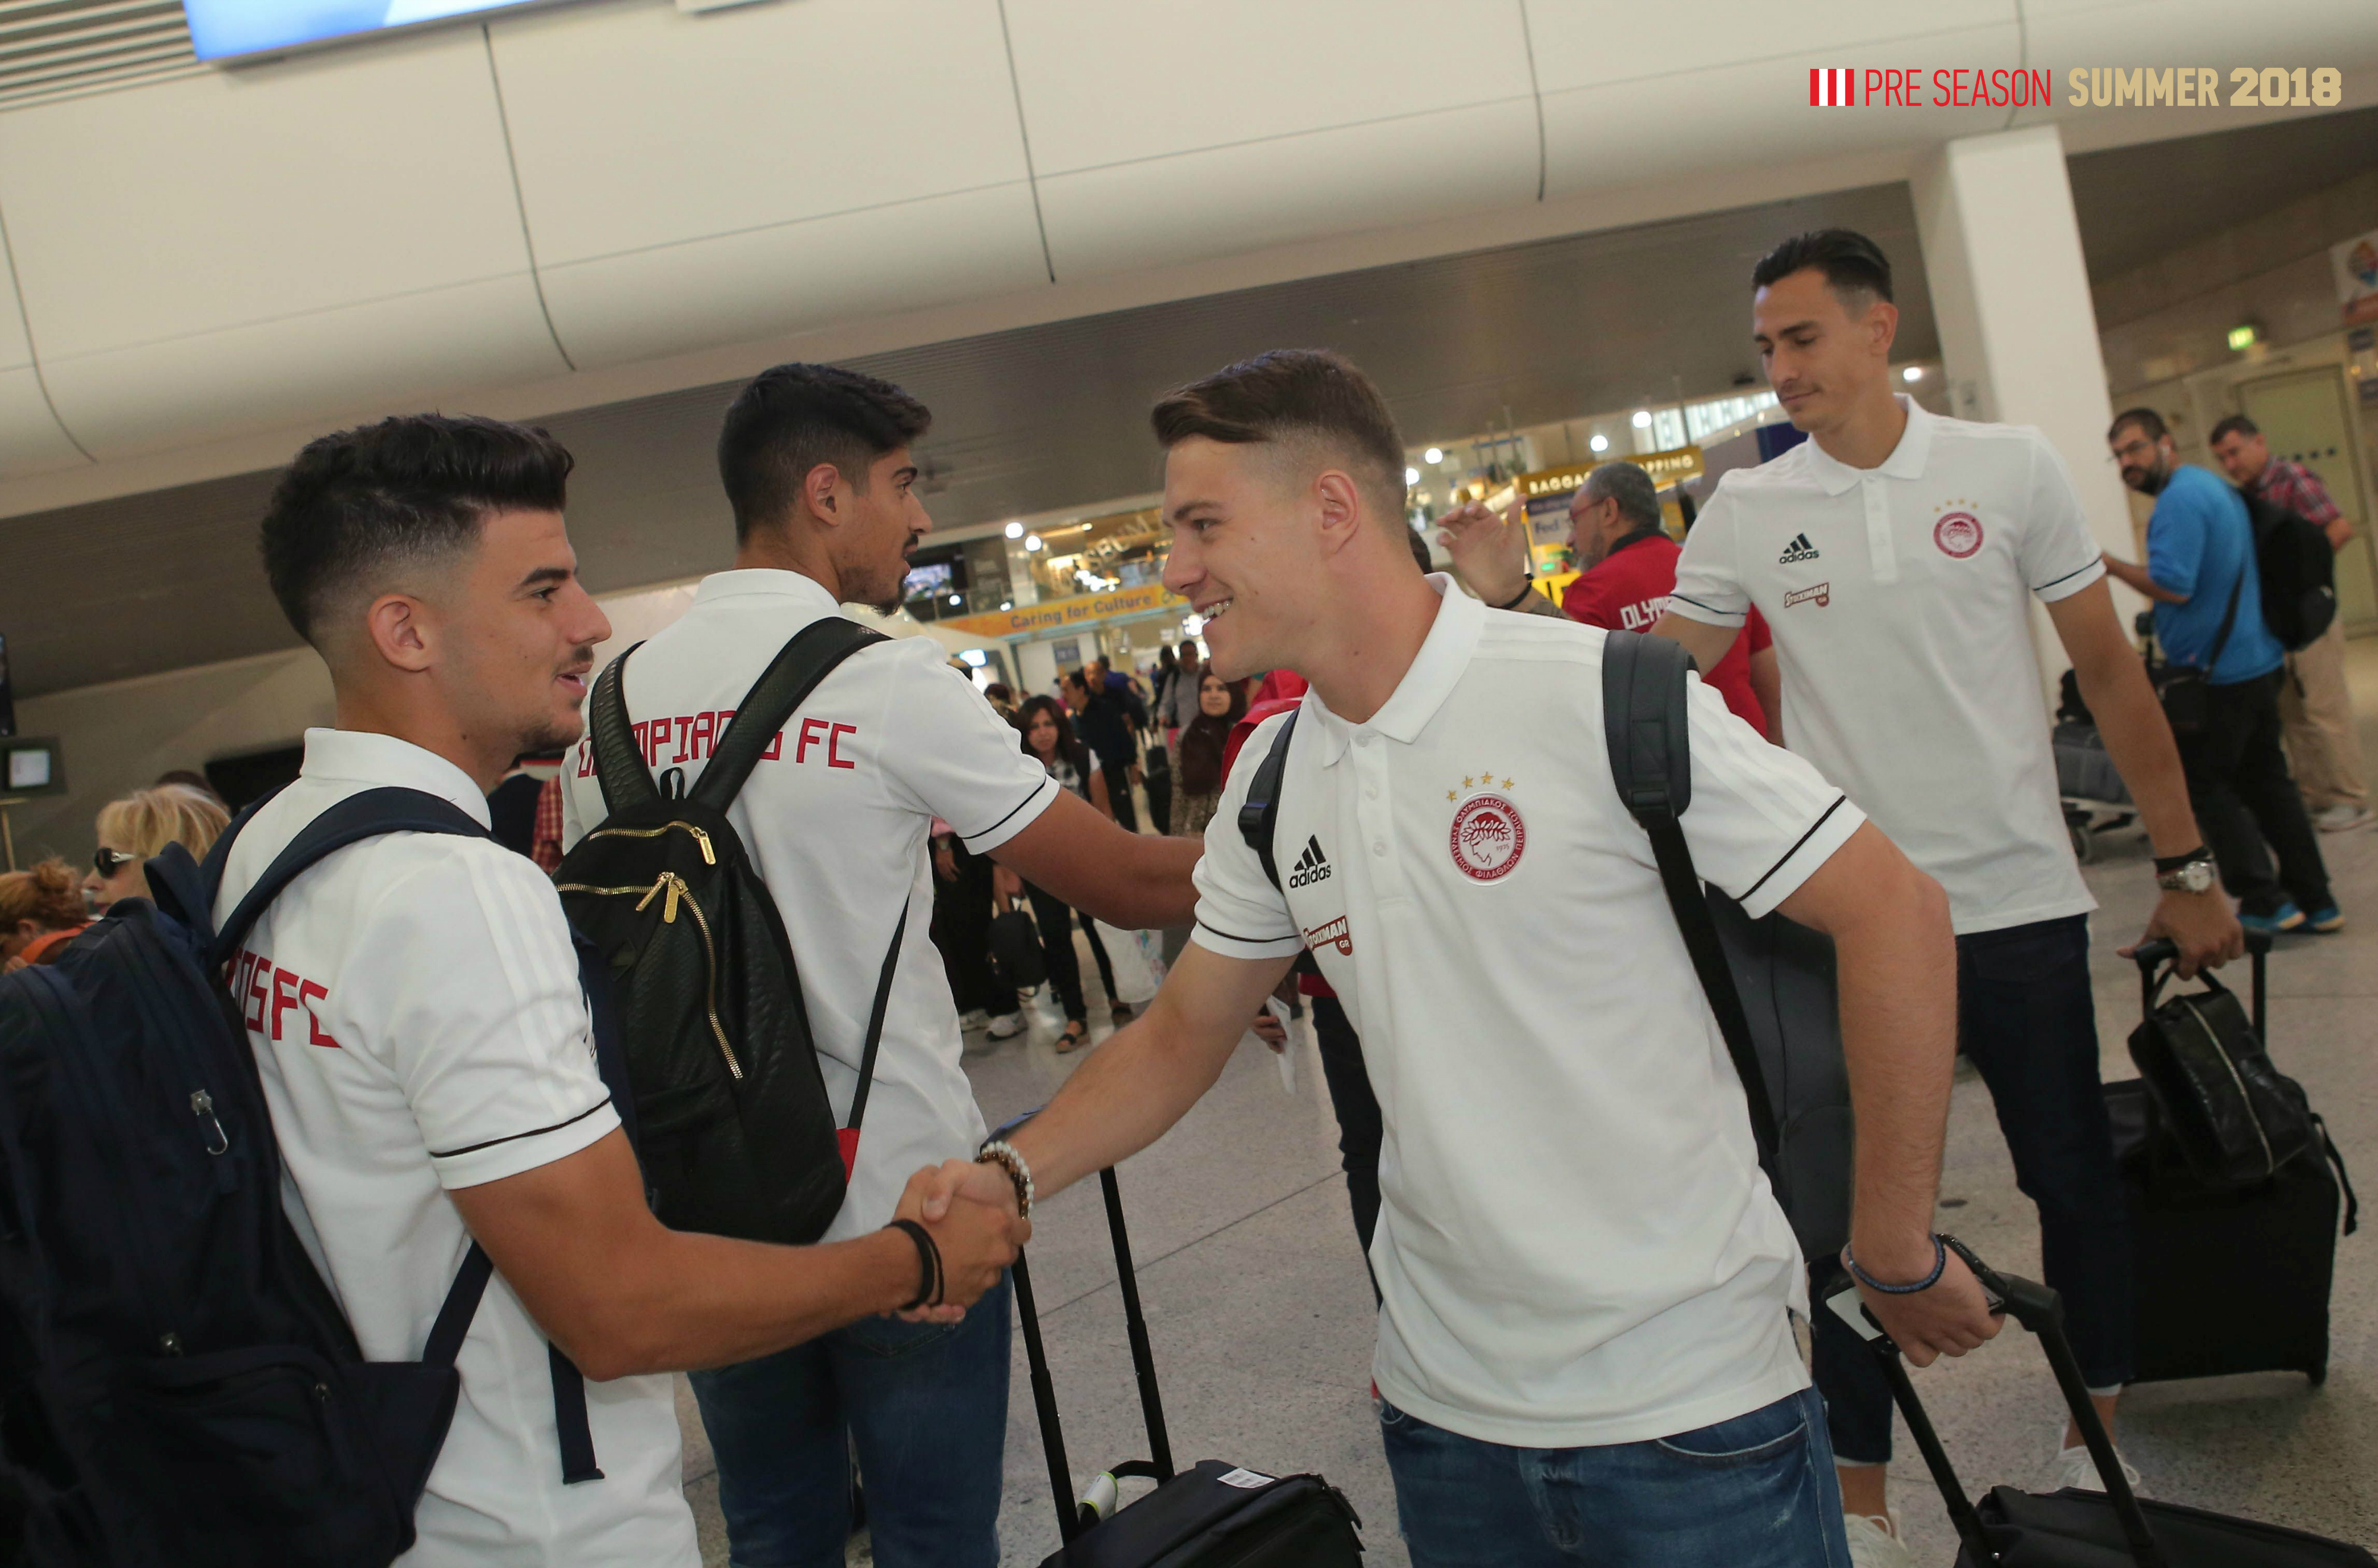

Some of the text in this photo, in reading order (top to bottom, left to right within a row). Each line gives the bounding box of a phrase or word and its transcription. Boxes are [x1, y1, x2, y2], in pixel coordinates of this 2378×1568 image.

[1638, 454, 1694, 473] PPING
[1779, 550, 1819, 564] adidas
[1011, 610, 1062, 628] Caring
[1067, 605, 1089, 619] for
[1094, 595, 1152, 613] Culture
[796, 717, 857, 769] FC
[1457, 798, 1506, 824] ΟΛΥΜΠΙΑΚΟΣ
[1496, 843, 1510, 852] 1925
[1289, 864, 1332, 889] adidas
[1476, 853, 1519, 879] ΦΙΛΑΘΛΩΝ
[1339, 939, 1351, 949] GR
[272, 967, 342, 1049] FC
